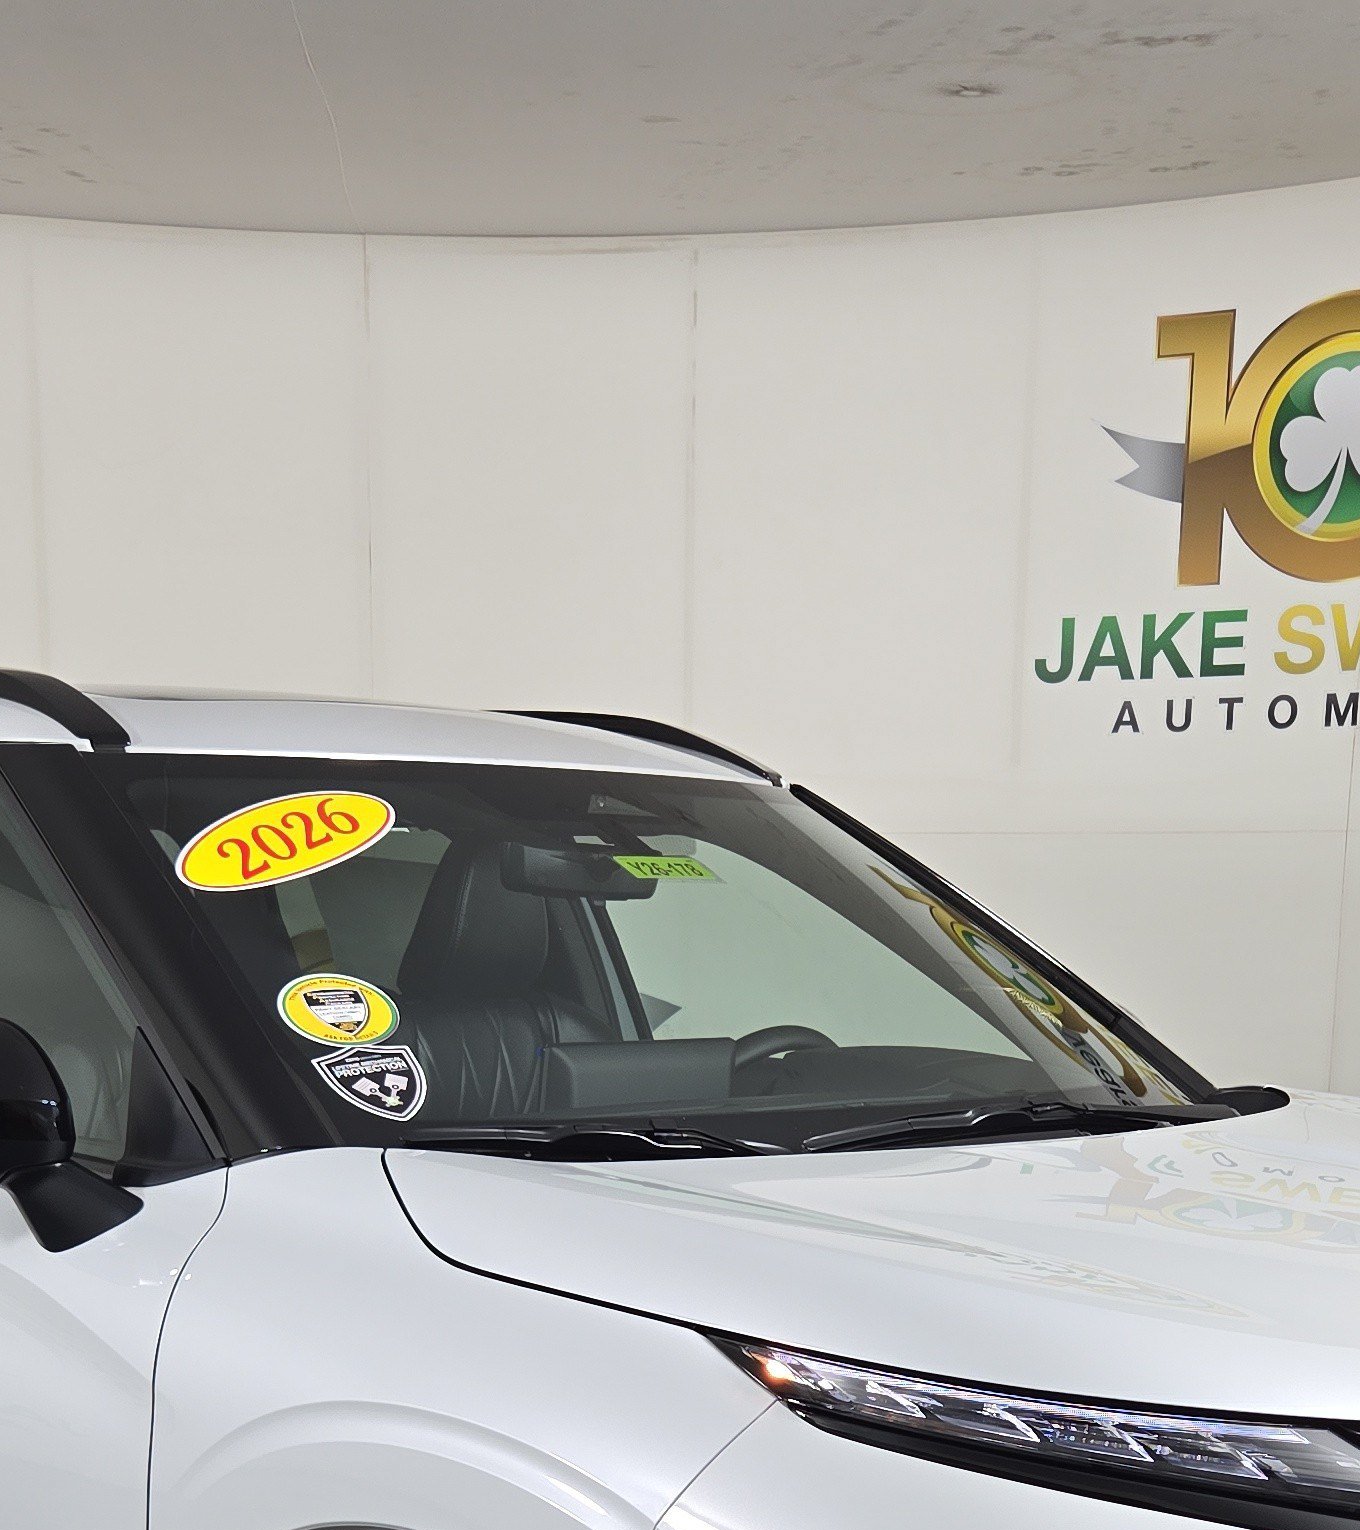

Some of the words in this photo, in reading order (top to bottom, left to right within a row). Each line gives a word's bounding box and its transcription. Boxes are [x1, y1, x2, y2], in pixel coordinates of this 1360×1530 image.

[1033, 608, 1249, 685] JAKE
[216, 796, 361, 880] 2026
[334, 1060, 408, 1079] PROTECTION
